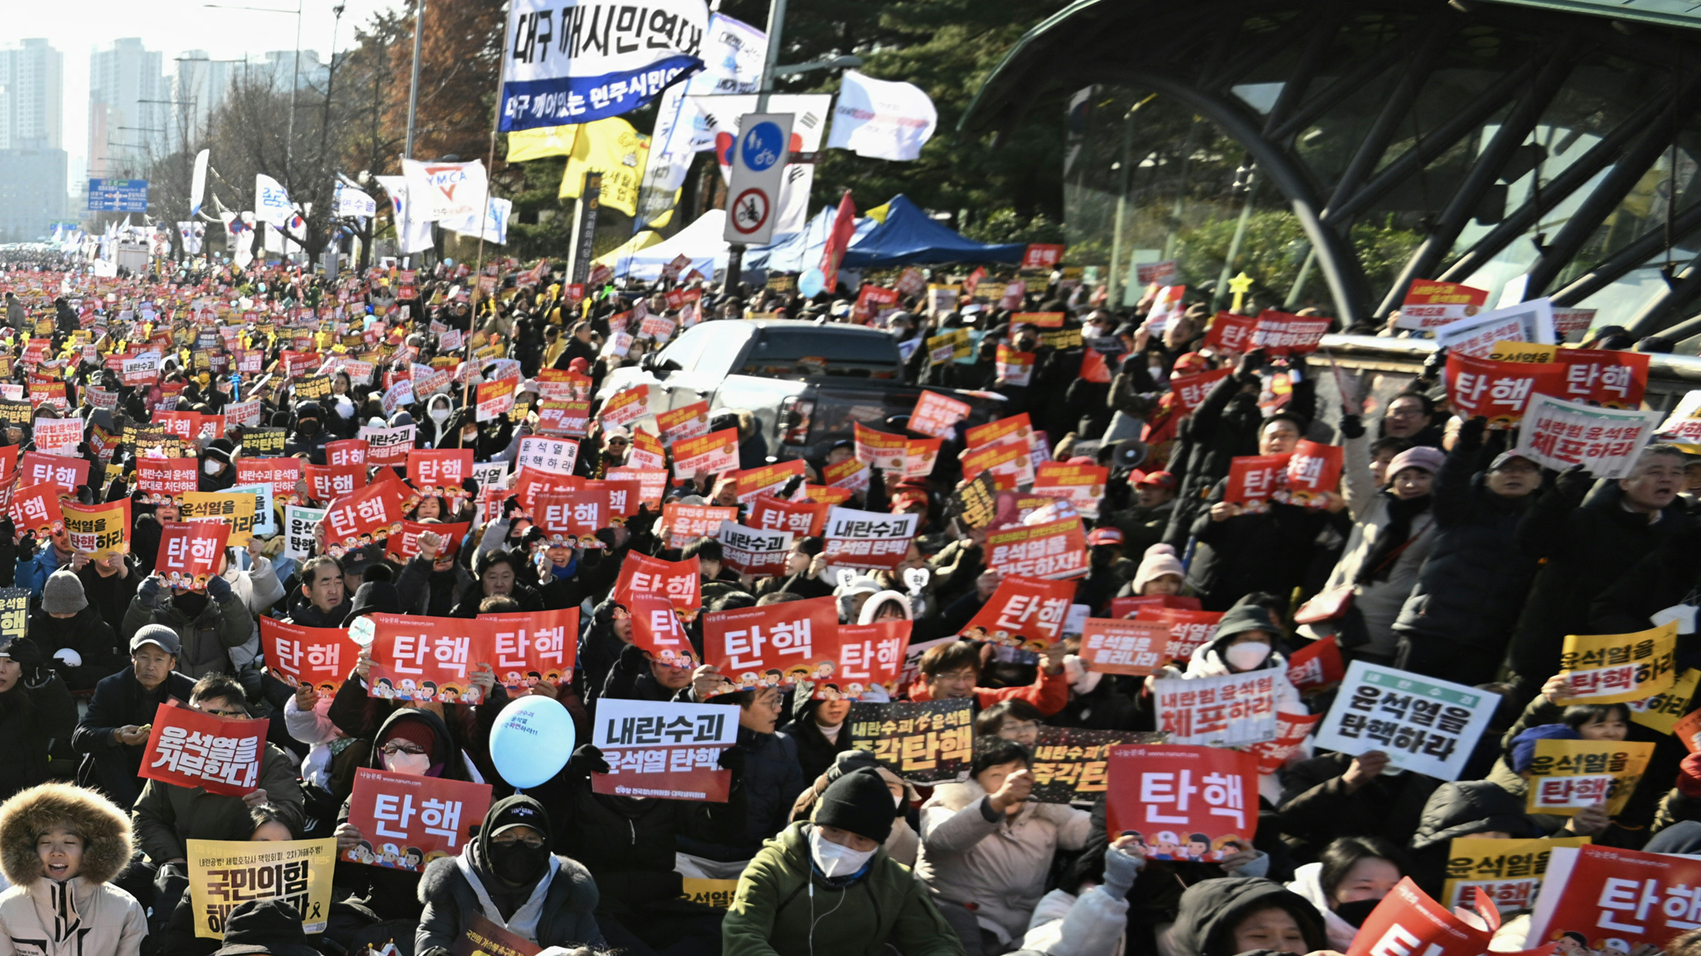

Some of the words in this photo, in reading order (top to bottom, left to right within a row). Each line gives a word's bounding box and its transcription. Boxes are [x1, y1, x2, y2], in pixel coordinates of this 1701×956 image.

[513, 10, 553, 63] 대구
[505, 95, 530, 119] 대구
[427, 171, 467, 186] YMCA
[138, 469, 168, 481] 내란수괴
[170, 469, 196, 480] 윤석열
[138, 480, 164, 493] 법대로
[166, 480, 197, 492] 처단하라
[239, 471, 272, 481] 내란수괴
[274, 470, 298, 480] 윤석열
[418, 458, 463, 483] 탄핵
[65, 516, 106, 534] 윤석열을
[328, 497, 388, 534] 탄핵
[834, 519, 908, 538] 내란수괴
[69, 527, 126, 558] 탄핵하라
[167, 537, 215, 569] 탄핵
[724, 530, 785, 551] 내란수괴
[825, 541, 867, 562] 윤석열
[869, 537, 908, 556] 탄핵!
[275, 638, 340, 676] 탄핵
[393, 634, 470, 677] 탄핵
[494, 626, 565, 668] 탄핵
[724, 618, 812, 669] 탄핵
[839, 638, 899, 679] 탄핵
[1161, 690, 1218, 708] 내란범
[1220, 676, 1274, 698] 윤석열
[606, 713, 724, 745] 내란수괴
[851, 719, 913, 738] 내란수괴
[932, 709, 972, 729] 윤석열
[1160, 697, 1274, 738] 체포하라
[1036, 742, 1099, 761] 내란수괴
[1338, 712, 1456, 762] 탄핵하라
[151, 751, 257, 788] 거부한다!
[1147, 751, 1199, 759] www.nanum.com
[1139, 768, 1246, 830] 탄핵
[373, 792, 462, 847] 탄핵
[207, 860, 309, 901] 국민의힘
